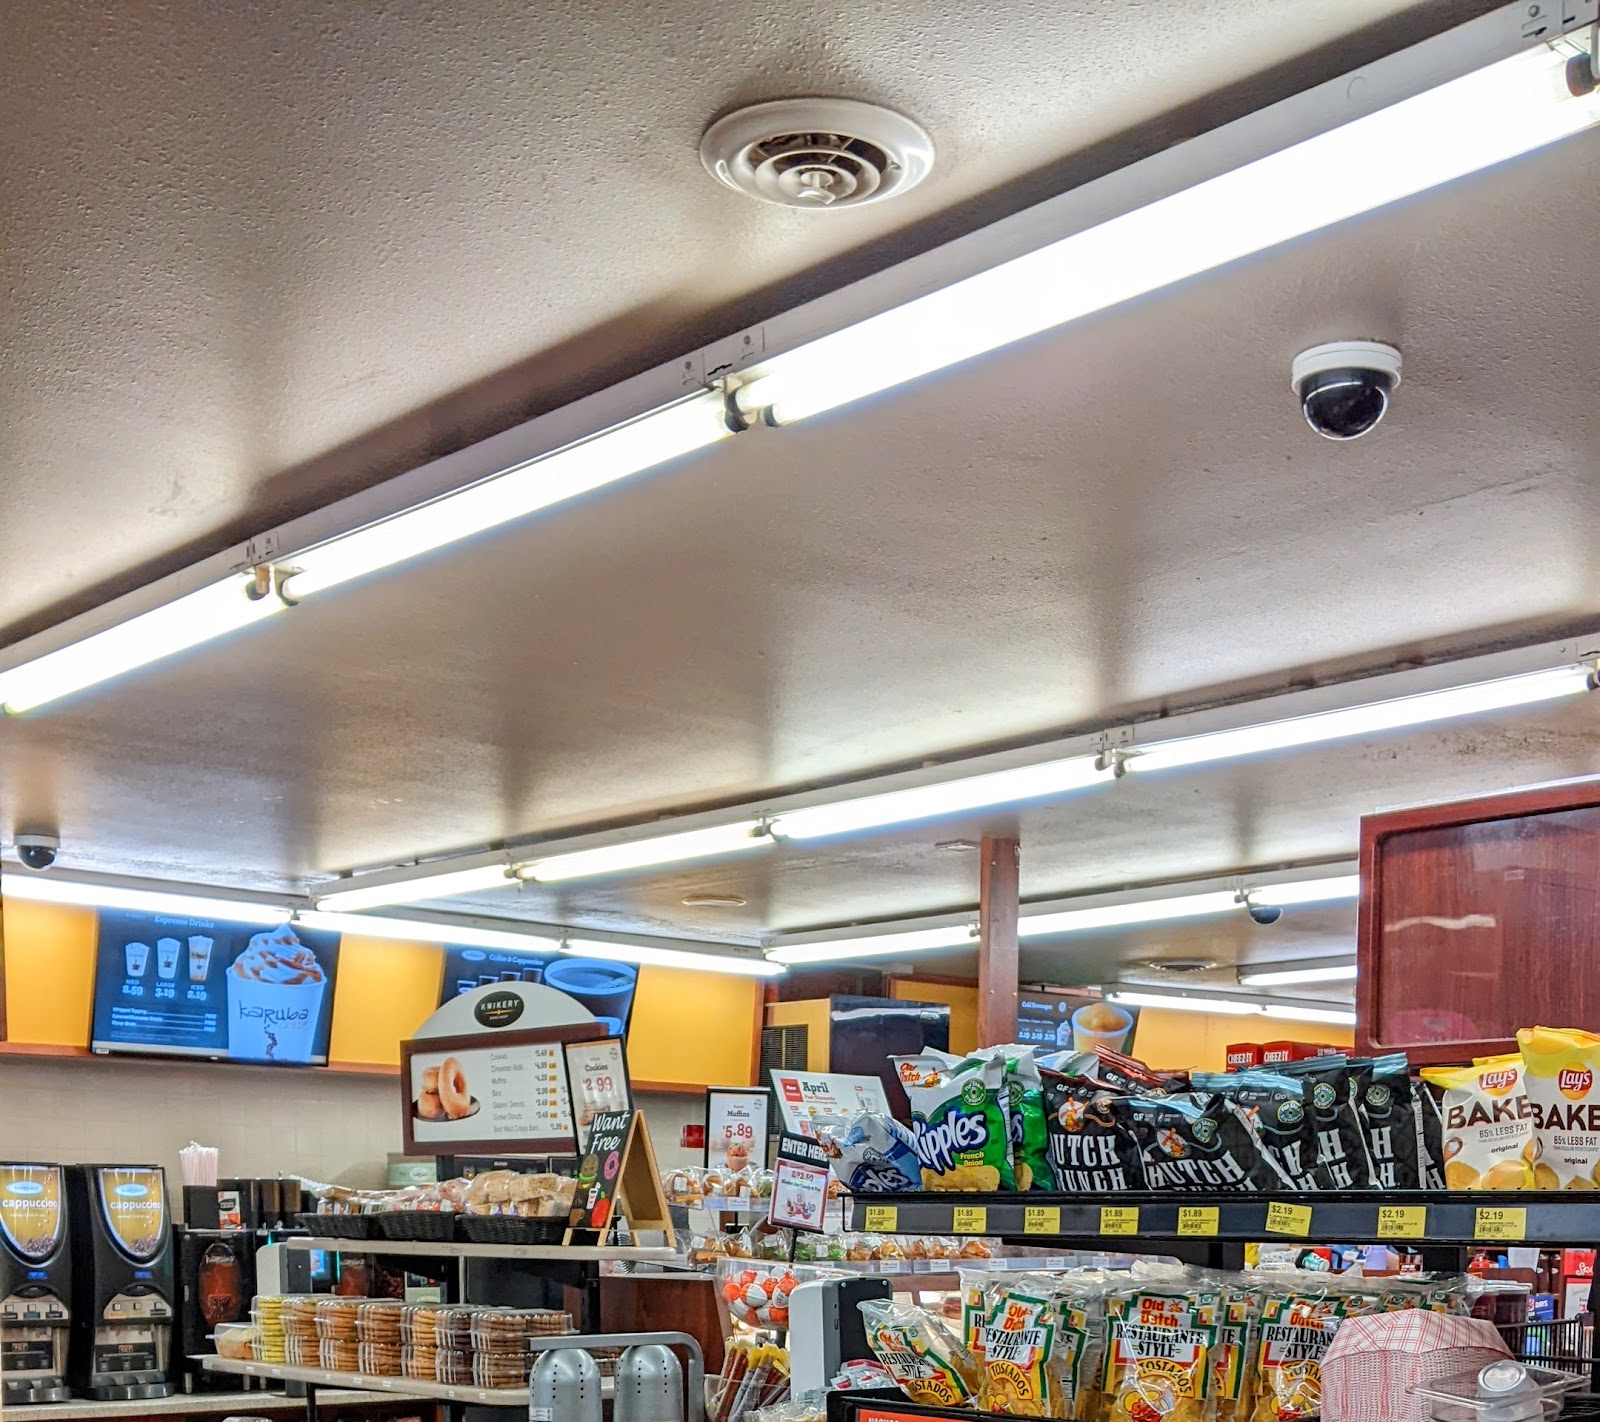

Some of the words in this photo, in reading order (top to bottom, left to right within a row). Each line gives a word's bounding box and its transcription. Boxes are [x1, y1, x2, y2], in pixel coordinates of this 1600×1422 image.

[189, 920, 214, 928] Drinks
[584, 1064, 608, 1072] Cookies
[900, 1062, 918, 1072] Old
[1106, 1072, 1118, 1081] GF
[802, 1081, 829, 1094] April
[1056, 1084, 1069, 1092] GF
[592, 1112, 630, 1132] Want
[1133, 1112, 1144, 1120] GF
[723, 1123, 752, 1138] $5.89
[1495, 1125, 1514, 1136] LESS
[1516, 1123, 1528, 1133] FAT
[590, 1133, 620, 1154] Free
[1554, 1136, 1566, 1145] 65%
[1567, 1136, 1584, 1146] LESS
[1586, 1136, 1597, 1146] FAT
[781, 1138, 807, 1157] ENTER
[1050, 1133, 1120, 1167] UTCH
[1491, 1143, 1518, 1153] original
[960, 1151, 984, 1160] French
[963, 1159, 984, 1167] Onion
[1158, 1149, 1245, 1184] UTCH
[862, 1168, 909, 1192] ples
[2, 1198, 57, 1210] cappuccino
[110, 1199, 161, 1211] cappuccino
[1272, 1204, 1293, 1215] $2.19
[1104, 1209, 1123, 1218] $1.89
[1183, 1209, 1202, 1218] $1.89
[1382, 1210, 1404, 1218] $2.19
[1480, 1210, 1503, 1220] $2.19
[1142, 1298, 1165, 1311] Old
[1535, 1300, 1548, 1308] DAYS
[986, 1328, 1041, 1345] ESTAURANTE
[1116, 1324, 1204, 1344] RESTAURANTE
[1266, 1326, 1335, 1346] RESTAURAN
[1138, 1341, 1175, 1358] STYLE
[1285, 1343, 1322, 1360] STYLE
